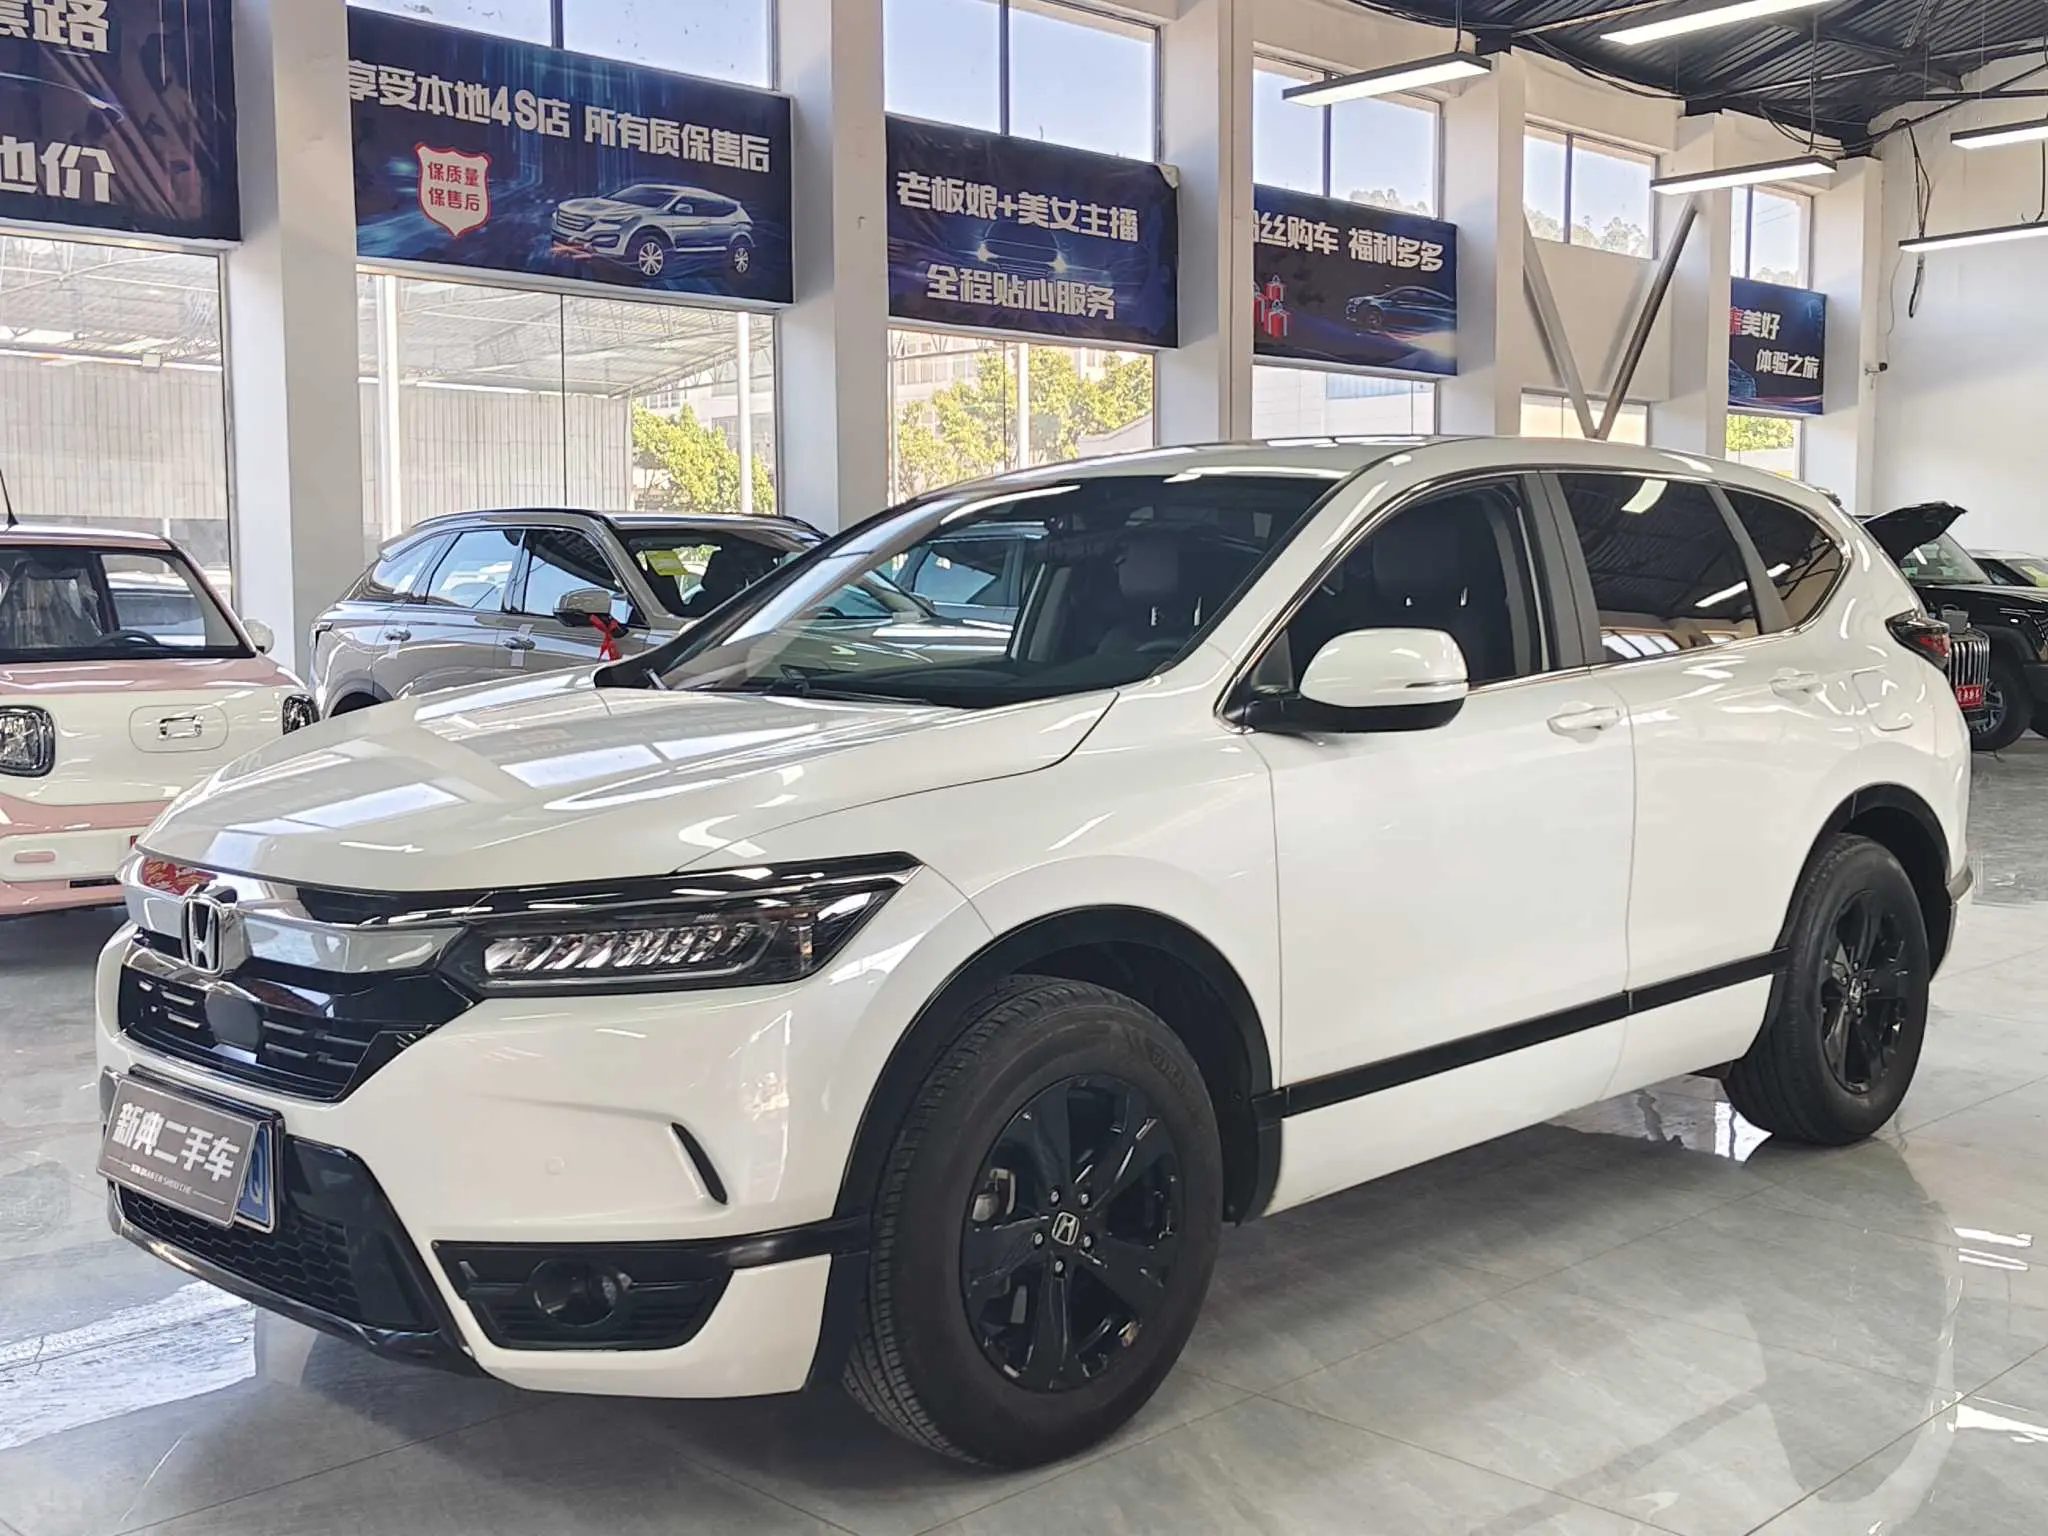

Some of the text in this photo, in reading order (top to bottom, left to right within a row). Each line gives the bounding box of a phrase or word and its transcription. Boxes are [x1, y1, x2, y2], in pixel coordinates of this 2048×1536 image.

[348, 58, 770, 173] 享受本地4S店 所有质保售后
[427, 160, 480, 188] 保质量
[428, 187, 480, 212] 保售后
[897, 171, 1138, 242] 老板娘+美女主播
[1348, 227, 1442, 272] 福利多多
[926, 263, 1116, 320] 全程贴心服务
[1756, 349, 1820, 378] 体验之旅
